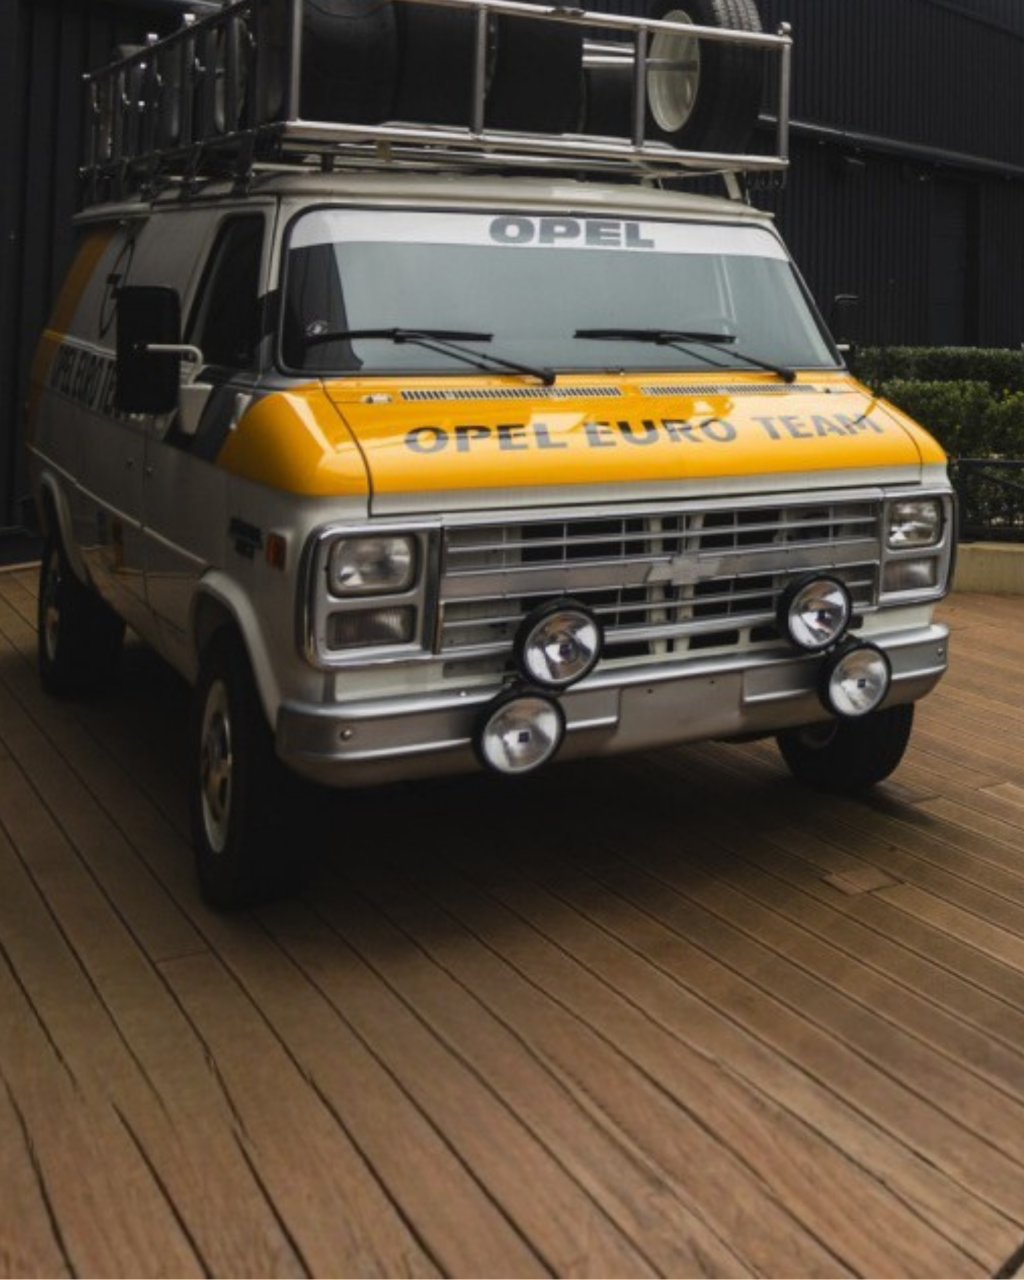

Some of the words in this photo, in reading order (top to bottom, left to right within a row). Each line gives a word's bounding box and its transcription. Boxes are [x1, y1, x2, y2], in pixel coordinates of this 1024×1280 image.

[489, 217, 655, 248] OPEL
[403, 422, 568, 454] OPEL
[582, 417, 737, 446] EURO
[750, 413, 884, 441] TEAM
